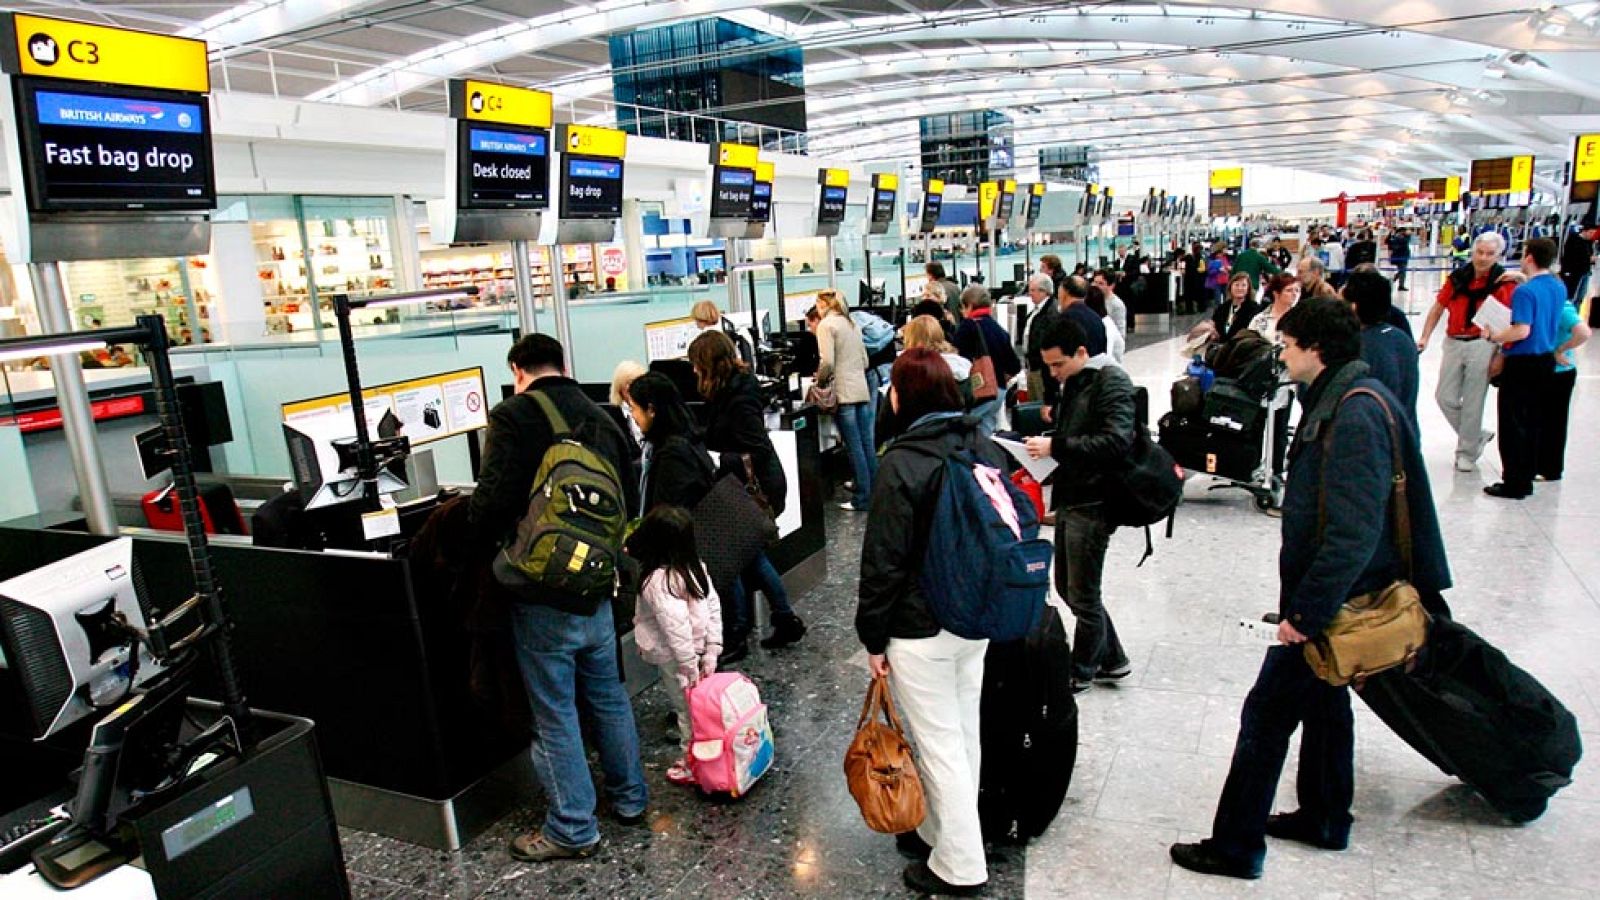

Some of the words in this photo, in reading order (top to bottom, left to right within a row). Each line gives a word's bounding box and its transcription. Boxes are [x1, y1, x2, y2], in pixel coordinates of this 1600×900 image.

[68, 40, 99, 64] C3
[488, 96, 502, 111] C4
[59, 108, 102, 122] BRITISH
[104, 111, 146, 125] AIRWAYS
[1587, 142, 1596, 157] E
[45, 143, 92, 165] Fast
[98, 144, 139, 172] bag
[145, 146, 193, 173] drop
[473, 163, 498, 179] Desk
[500, 164, 531, 180] closed
[569, 184, 584, 198] Bag
[585, 184, 602, 198] drop
[985, 188, 993, 199] E
